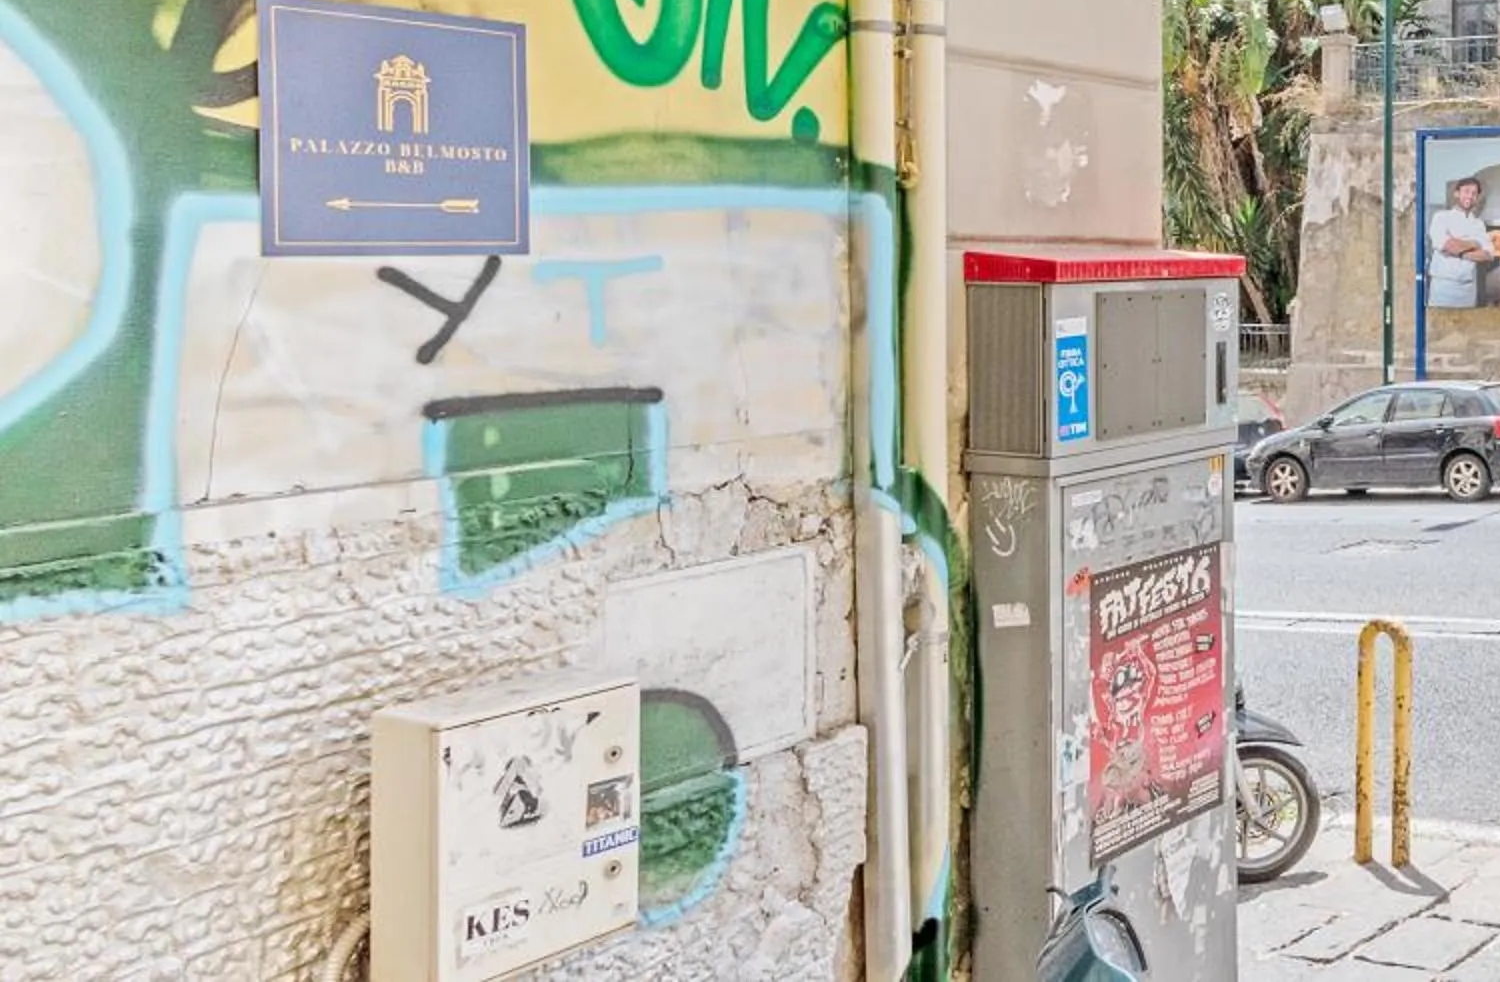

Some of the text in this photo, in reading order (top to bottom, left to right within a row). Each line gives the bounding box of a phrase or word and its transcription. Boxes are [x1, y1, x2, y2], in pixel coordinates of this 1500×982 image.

[290, 137, 508, 162] PALAZZO BELMOSTO
[384, 160, 425, 175] B&B
[584, 826, 640, 857] TITANIC
[465, 898, 531, 941] KES
